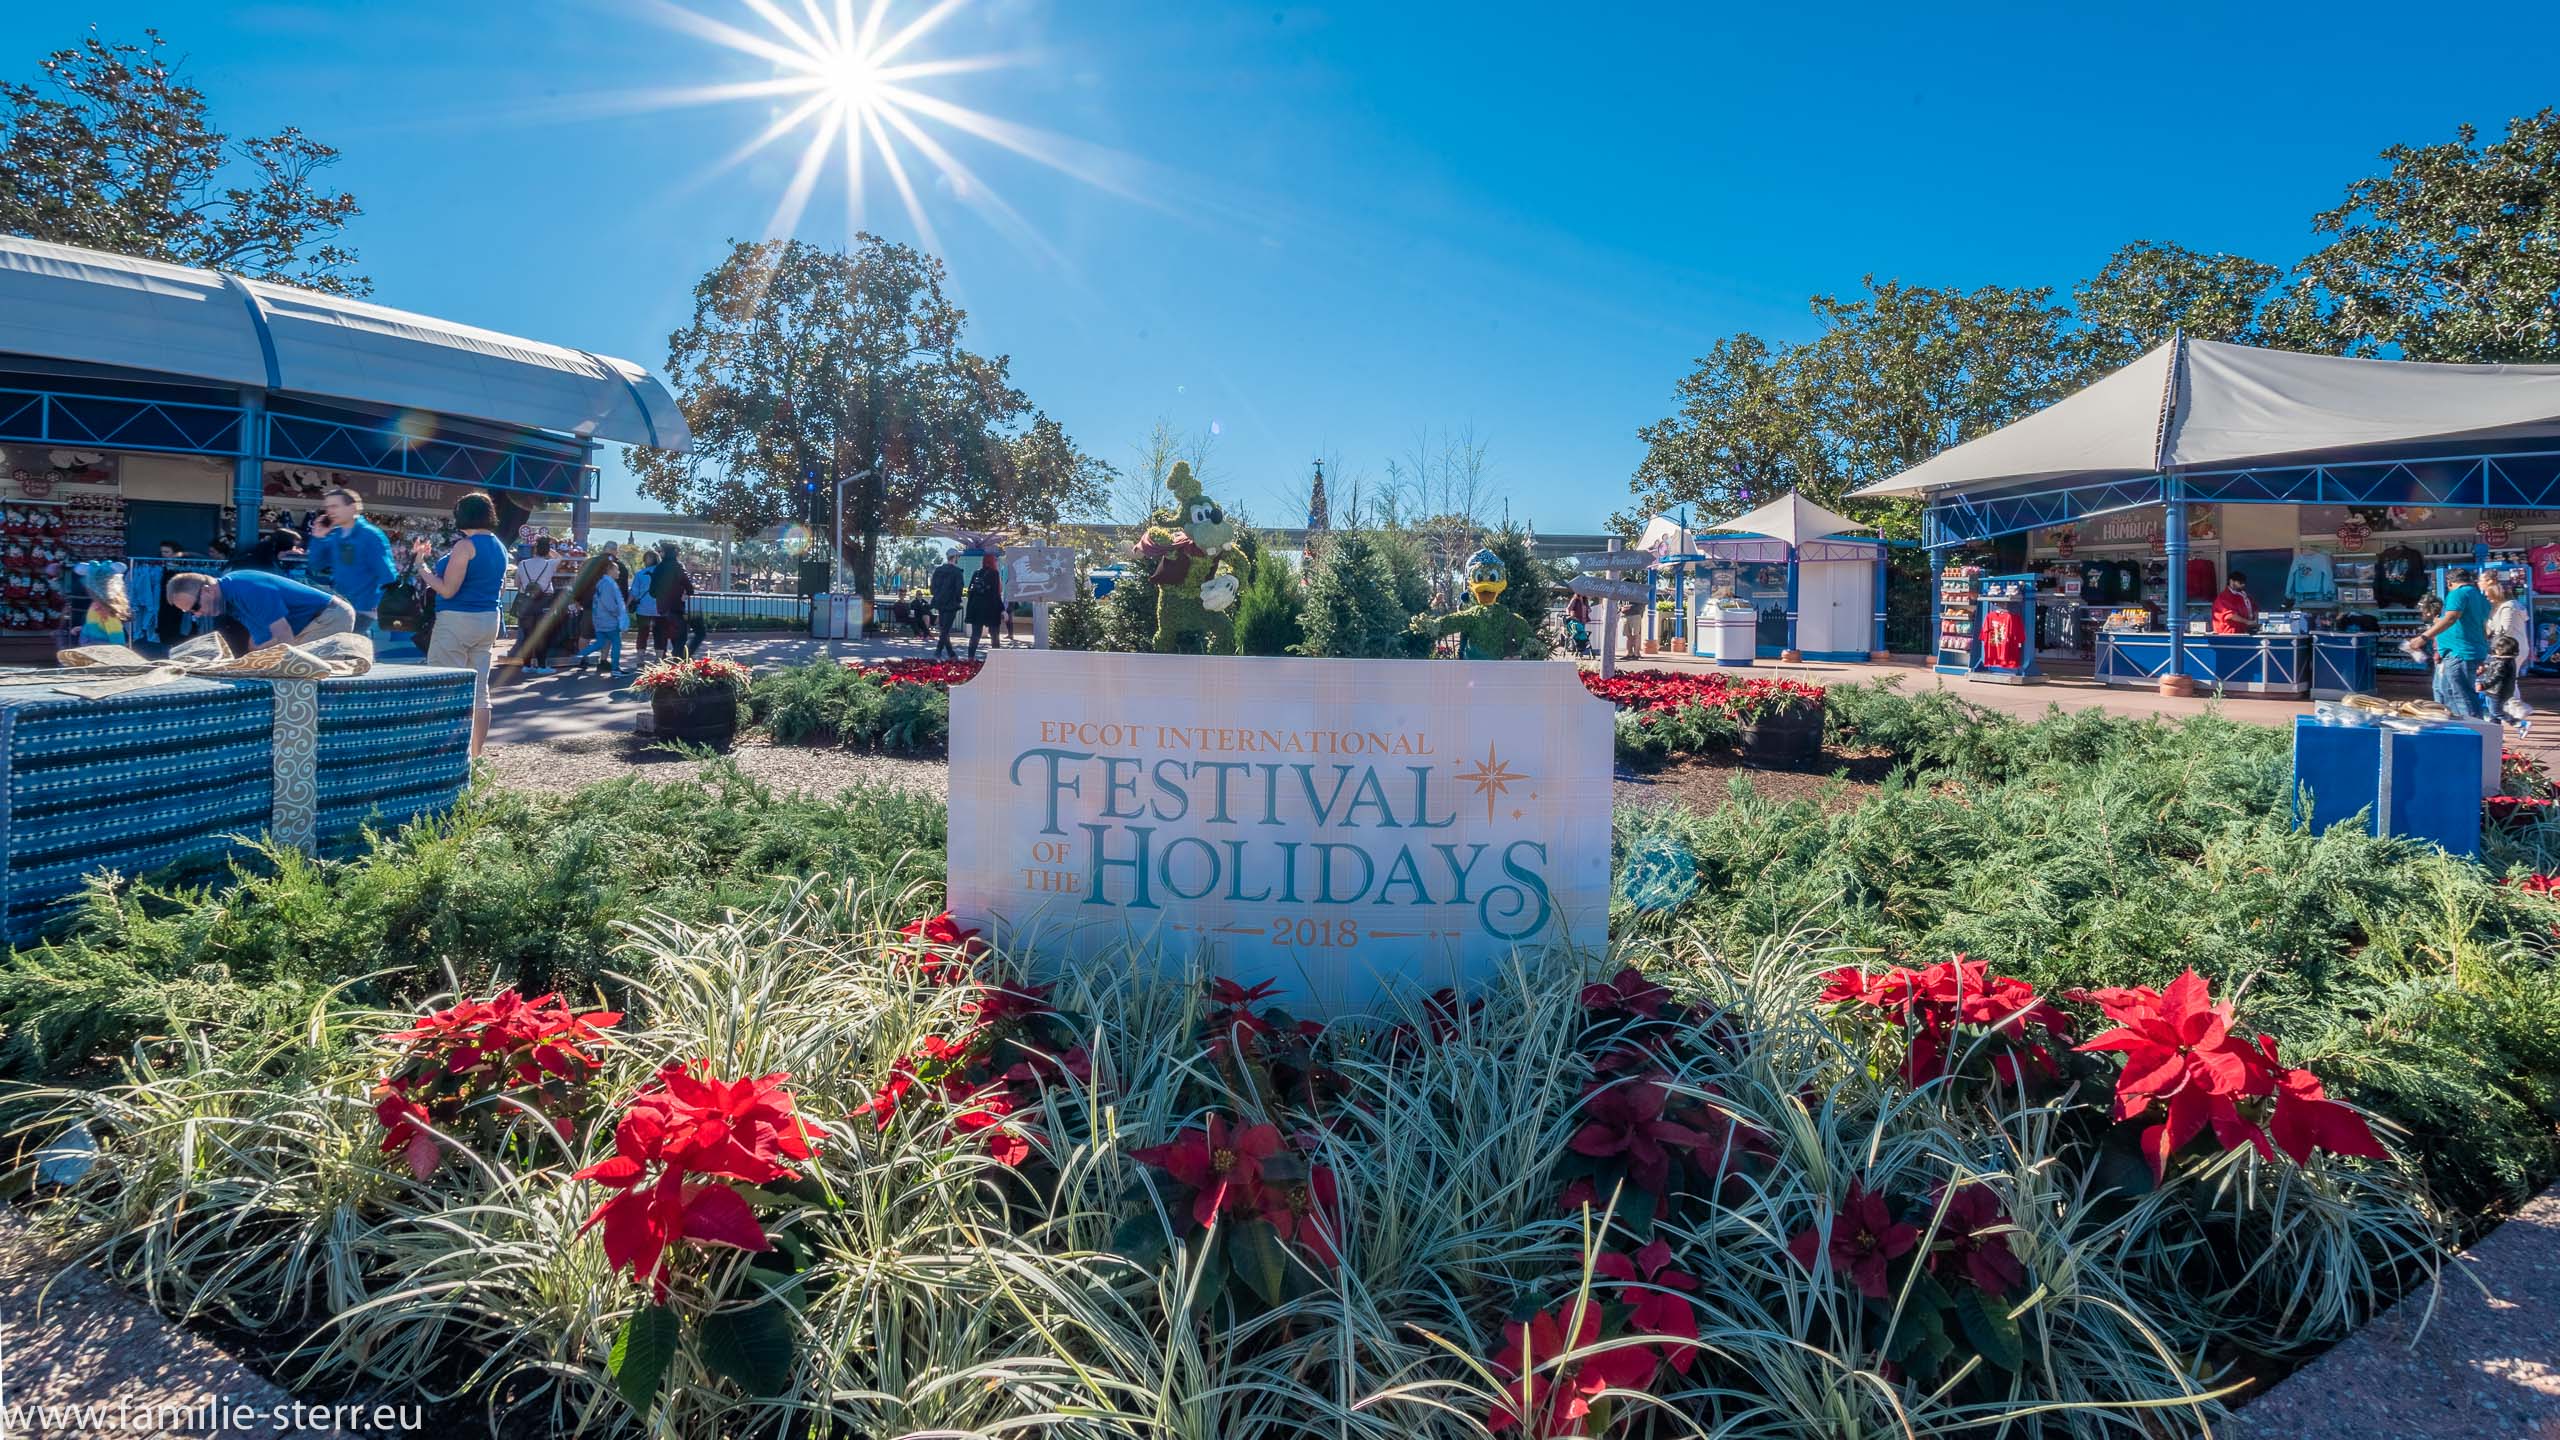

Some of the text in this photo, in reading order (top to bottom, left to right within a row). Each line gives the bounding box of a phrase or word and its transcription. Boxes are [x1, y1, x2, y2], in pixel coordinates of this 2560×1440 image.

[377, 479, 445, 500] MISTLETOE
[1039, 720, 1434, 755] EPCOT INTERNATIONAL
[1009, 747, 1456, 836] FESTIVAL
[1032, 841, 1071, 865] OF
[1021, 868, 1081, 893] THE
[1078, 822, 1552, 941] HOLIDAYS
[1271, 917, 1359, 948] 2018
